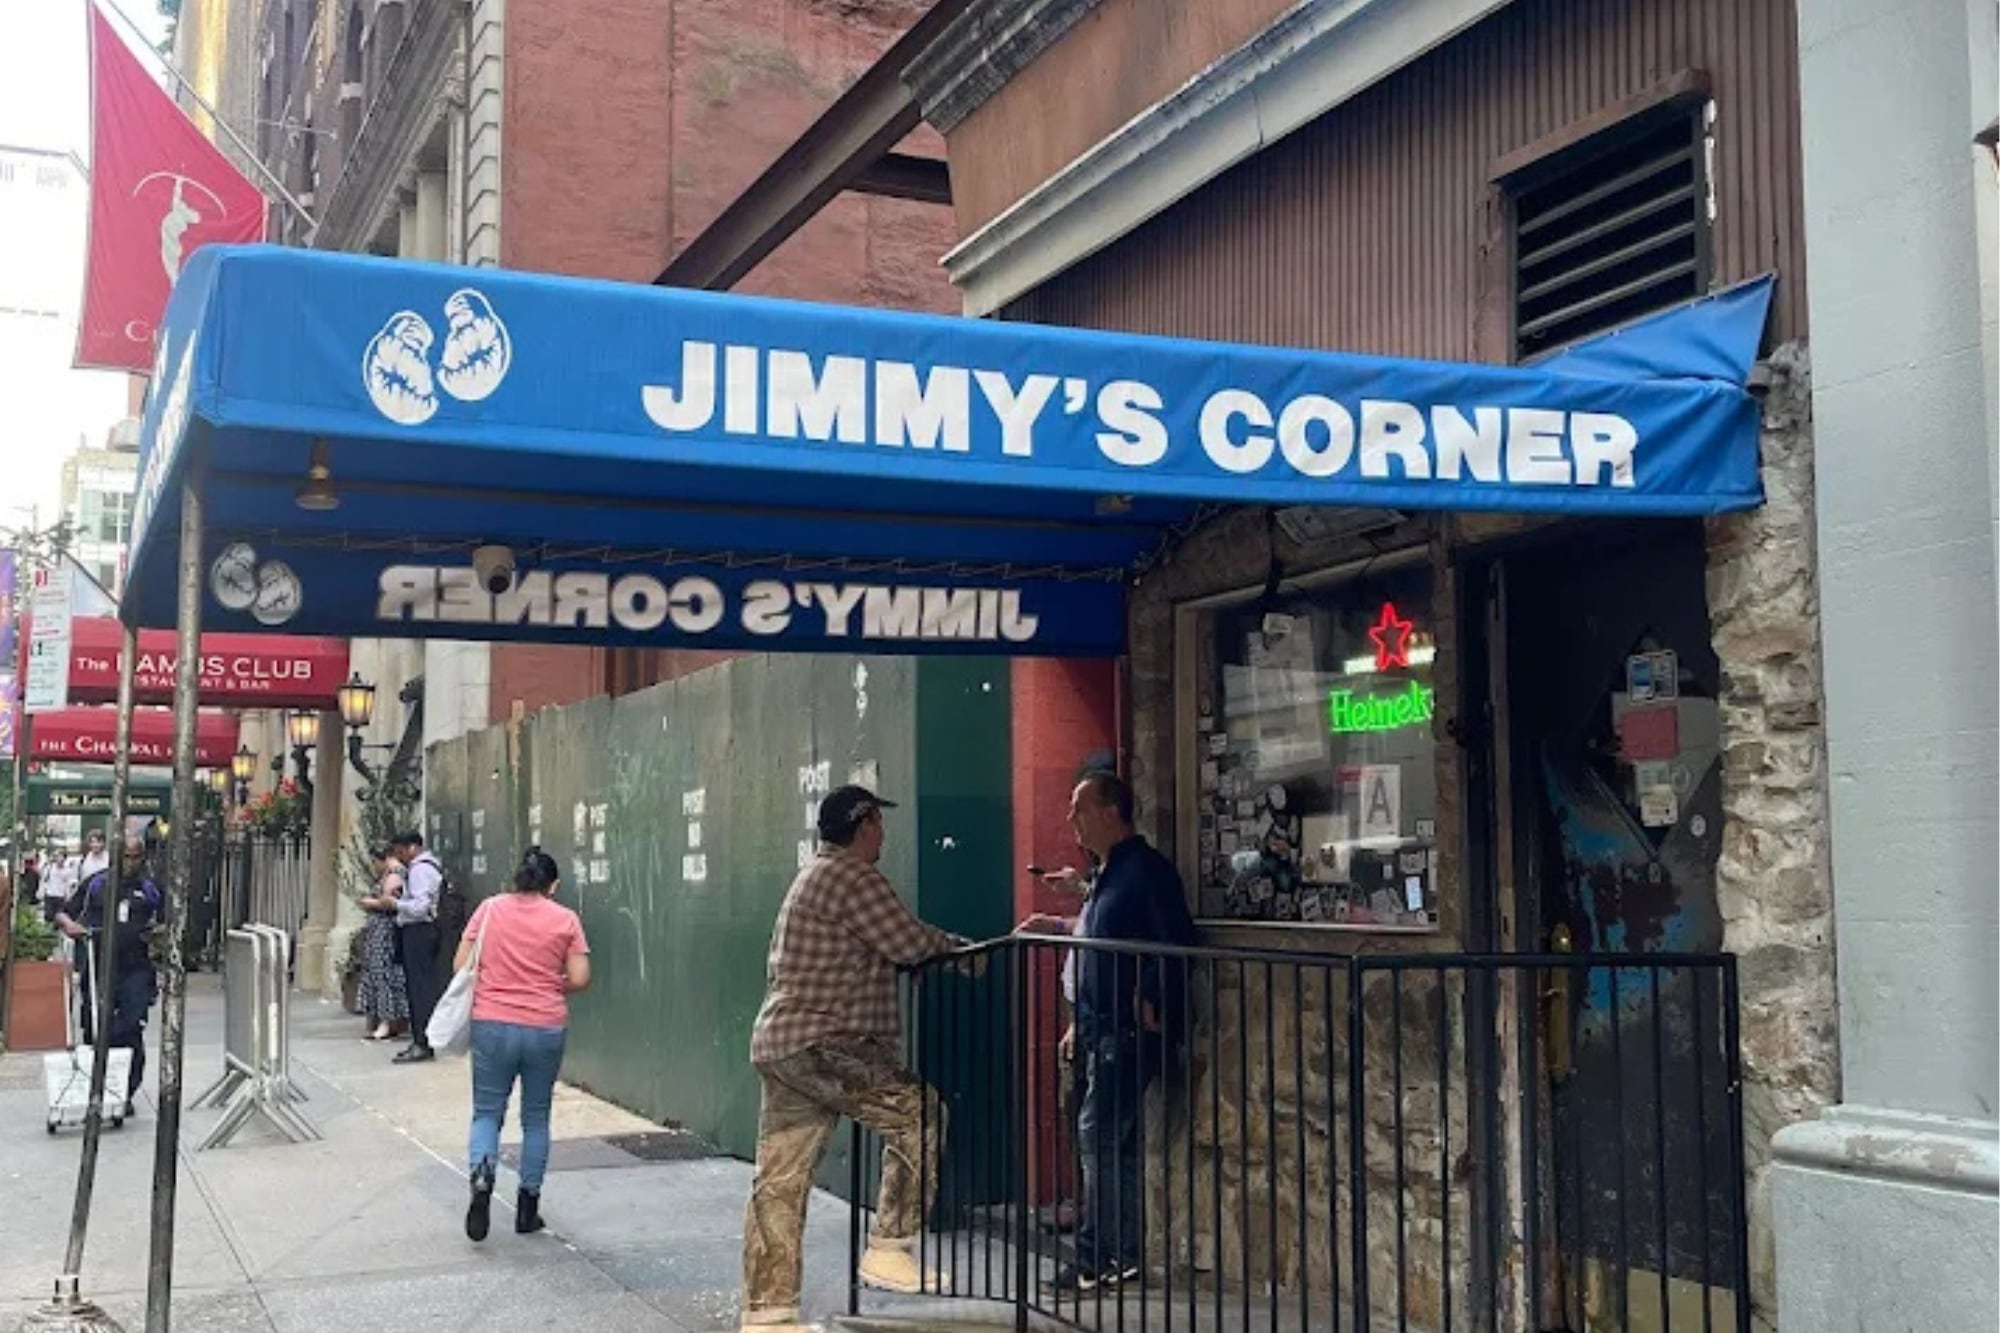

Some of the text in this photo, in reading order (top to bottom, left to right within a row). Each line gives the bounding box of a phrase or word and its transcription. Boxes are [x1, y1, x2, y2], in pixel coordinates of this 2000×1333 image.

[642, 340, 1639, 488] JIMMY'S CORNER
[76, 657, 109, 672] The
[232, 659, 312, 679] CLUB
[1366, 776, 1392, 824] A
